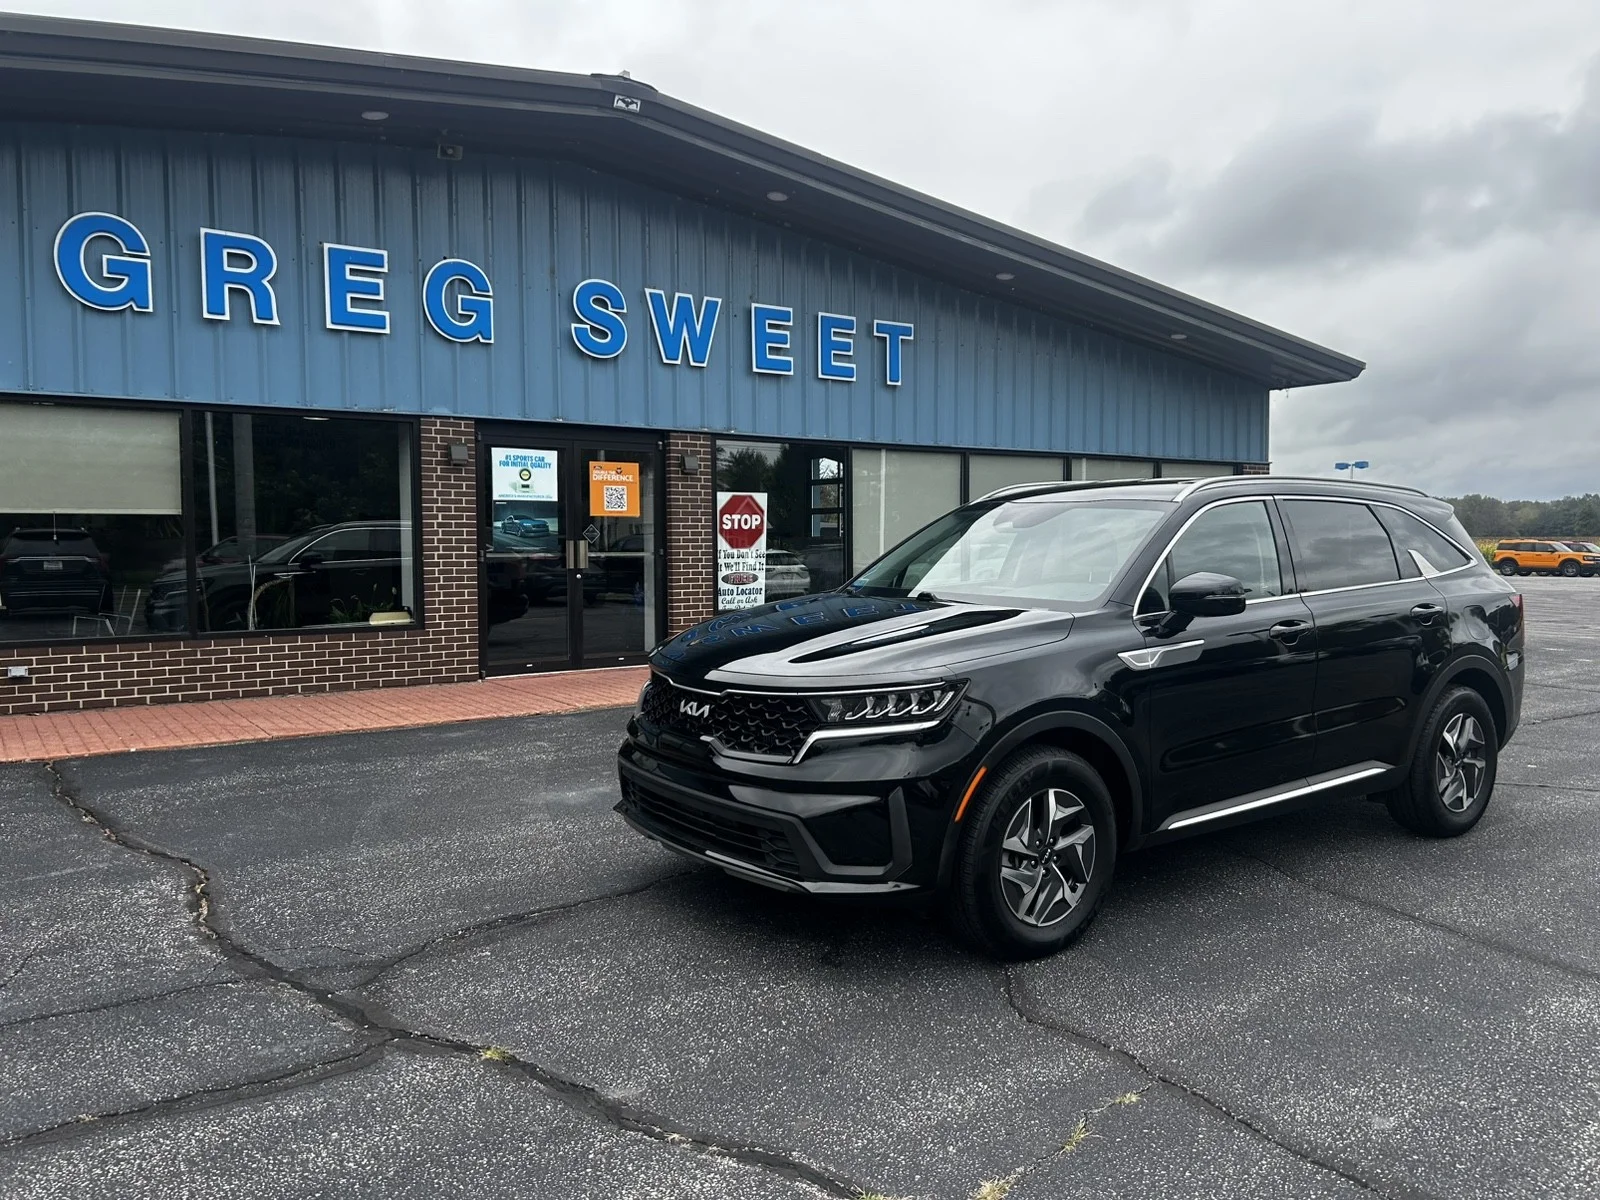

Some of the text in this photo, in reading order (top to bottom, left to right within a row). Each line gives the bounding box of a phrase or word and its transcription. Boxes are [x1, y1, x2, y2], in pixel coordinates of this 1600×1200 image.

[54, 211, 914, 386] GREG SWEET
[511, 460, 529, 468] INITIAL
[530, 461, 552, 469] QUALITY
[593, 474, 633, 482] DIFFERENCE
[722, 514, 761, 530] STOP
[722, 549, 735, 560] You
[736, 548, 754, 560] Don't
[724, 561, 741, 572] We'll
[742, 560, 757, 572] Find
[758, 561, 764, 571] It
[728, 573, 754, 584] FREE
[718, 586, 763, 597] Auto Locator
[721, 596, 736, 605] Call
[745, 595, 758, 604] Ask
[680, 699, 710, 718] KIA
